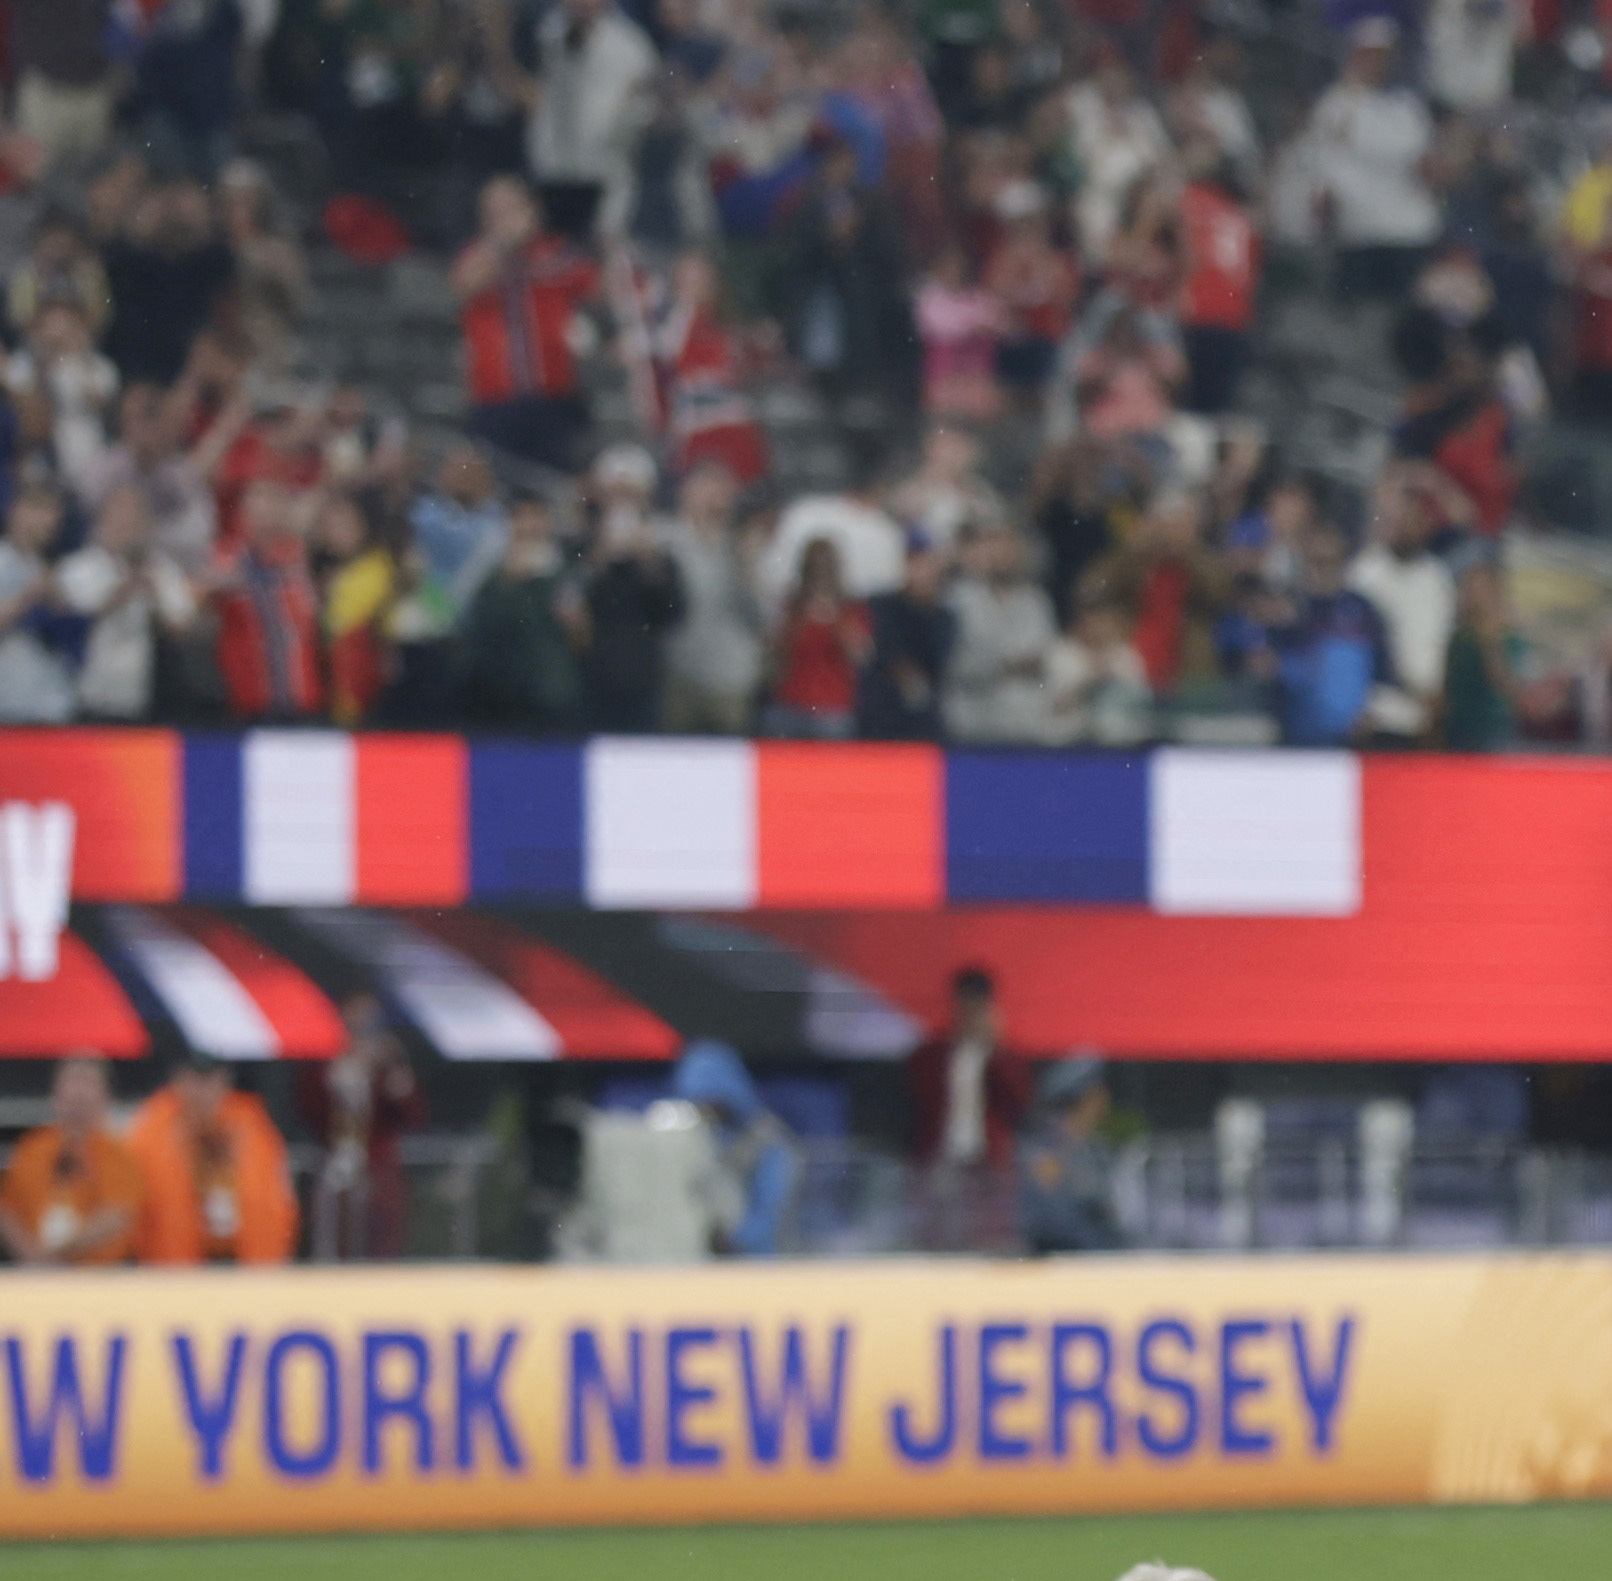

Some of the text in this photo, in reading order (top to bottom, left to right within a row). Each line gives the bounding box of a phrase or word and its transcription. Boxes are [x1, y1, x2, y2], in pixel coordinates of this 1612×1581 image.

[173, 1331, 524, 1478] YORK
[570, 1326, 849, 1468] NEW
[891, 1319, 1354, 1463] JERSEY
